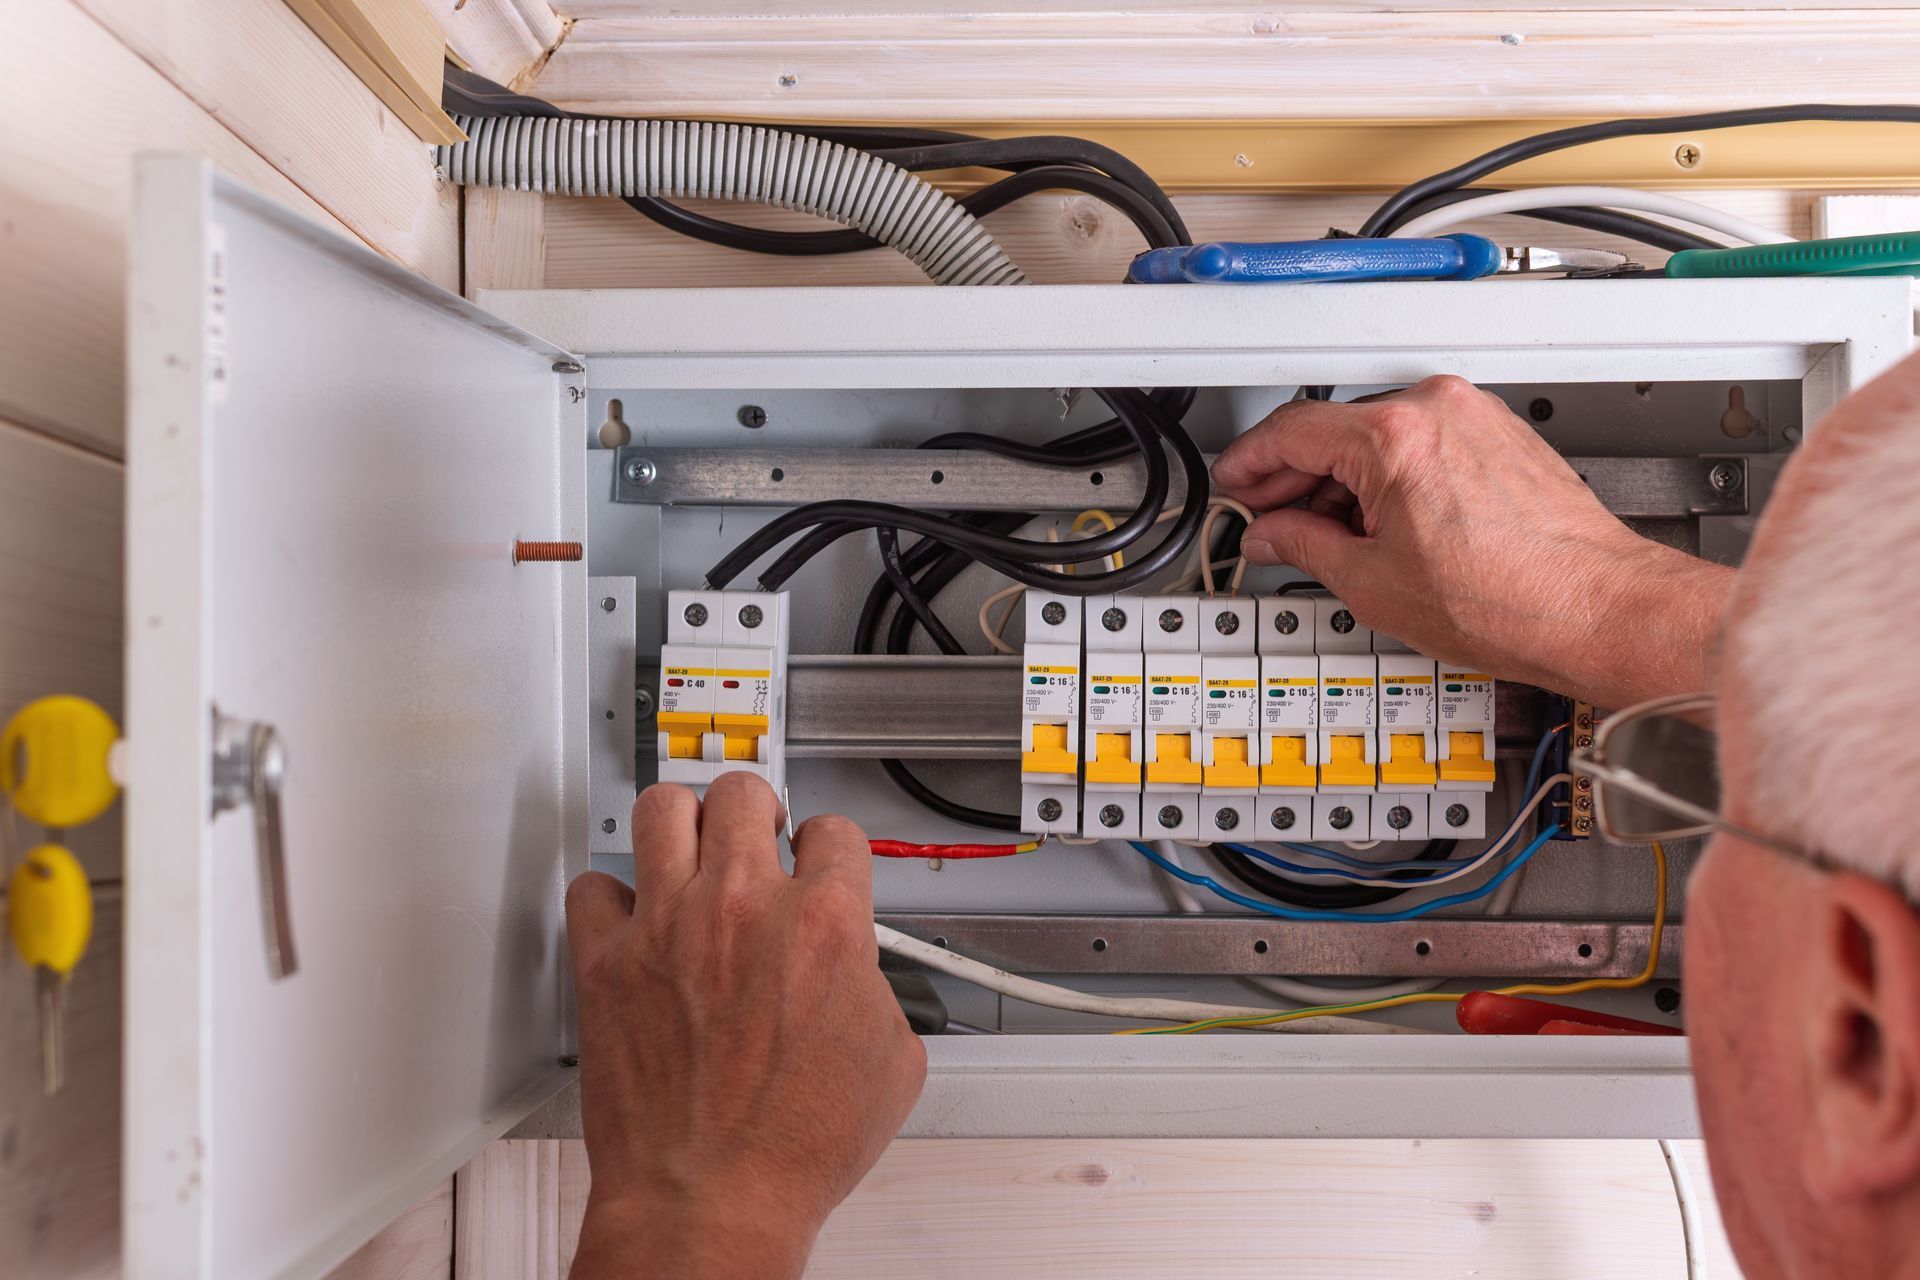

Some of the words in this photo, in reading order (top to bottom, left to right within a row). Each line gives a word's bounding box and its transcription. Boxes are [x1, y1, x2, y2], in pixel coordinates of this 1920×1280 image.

[695, 680, 705, 688] 40
[1406, 688, 1411, 696] C
[1414, 688, 1423, 696] 10
